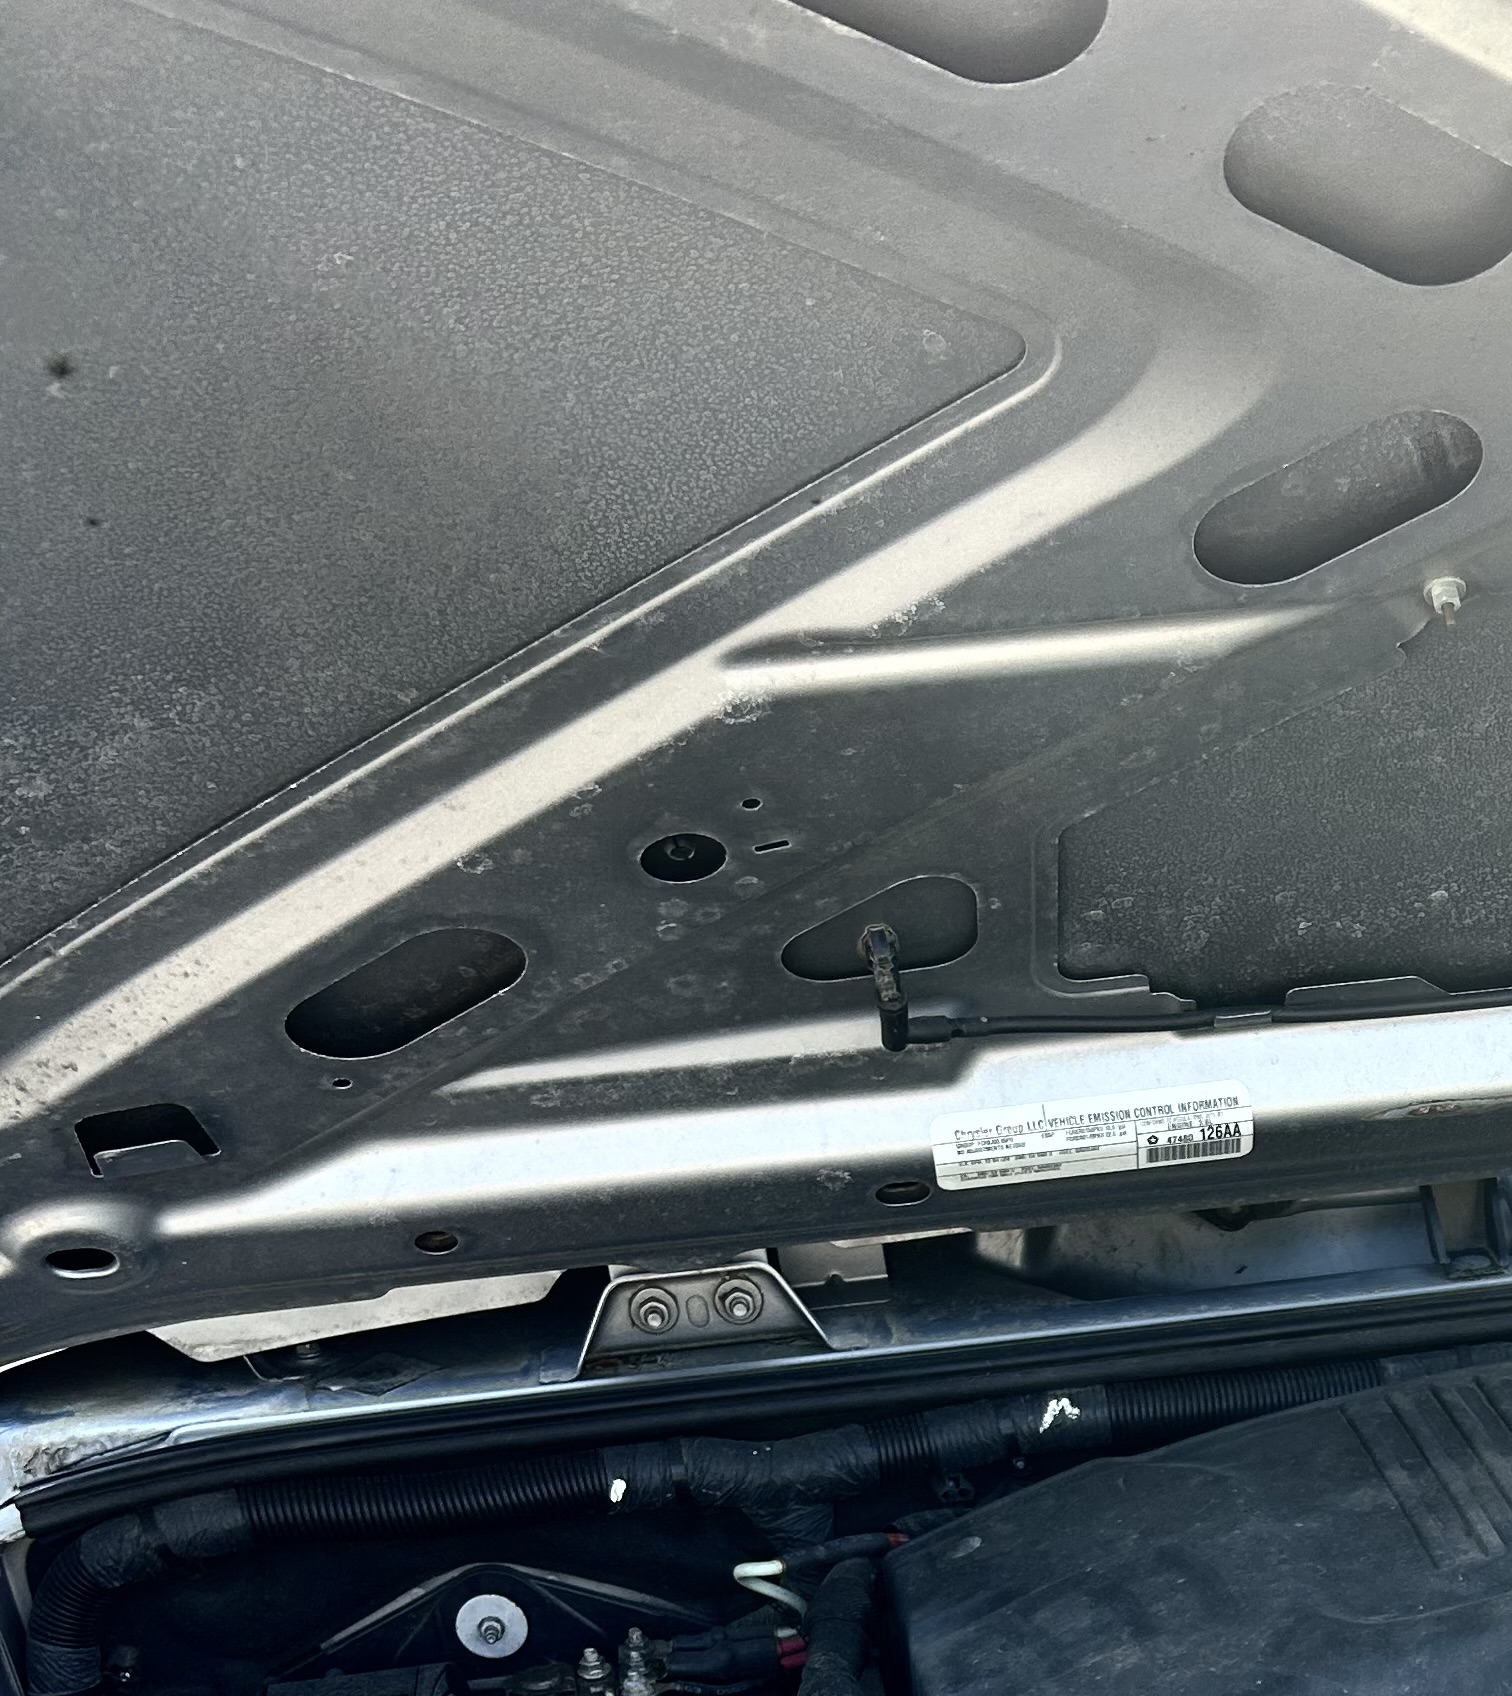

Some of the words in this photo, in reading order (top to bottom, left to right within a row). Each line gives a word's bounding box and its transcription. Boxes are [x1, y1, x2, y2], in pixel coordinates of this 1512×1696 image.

[1048, 1114, 1085, 1128] VEHICLE
[1088, 1108, 1131, 1123] EMISSION
[1134, 1103, 1174, 1118] CONTROL
[1178, 1096, 1239, 1113] INFORMATION
[996, 1123, 1024, 1136] Group
[1027, 1119, 1043, 1132] LLC
[1200, 1121, 1242, 1142] 126AA
